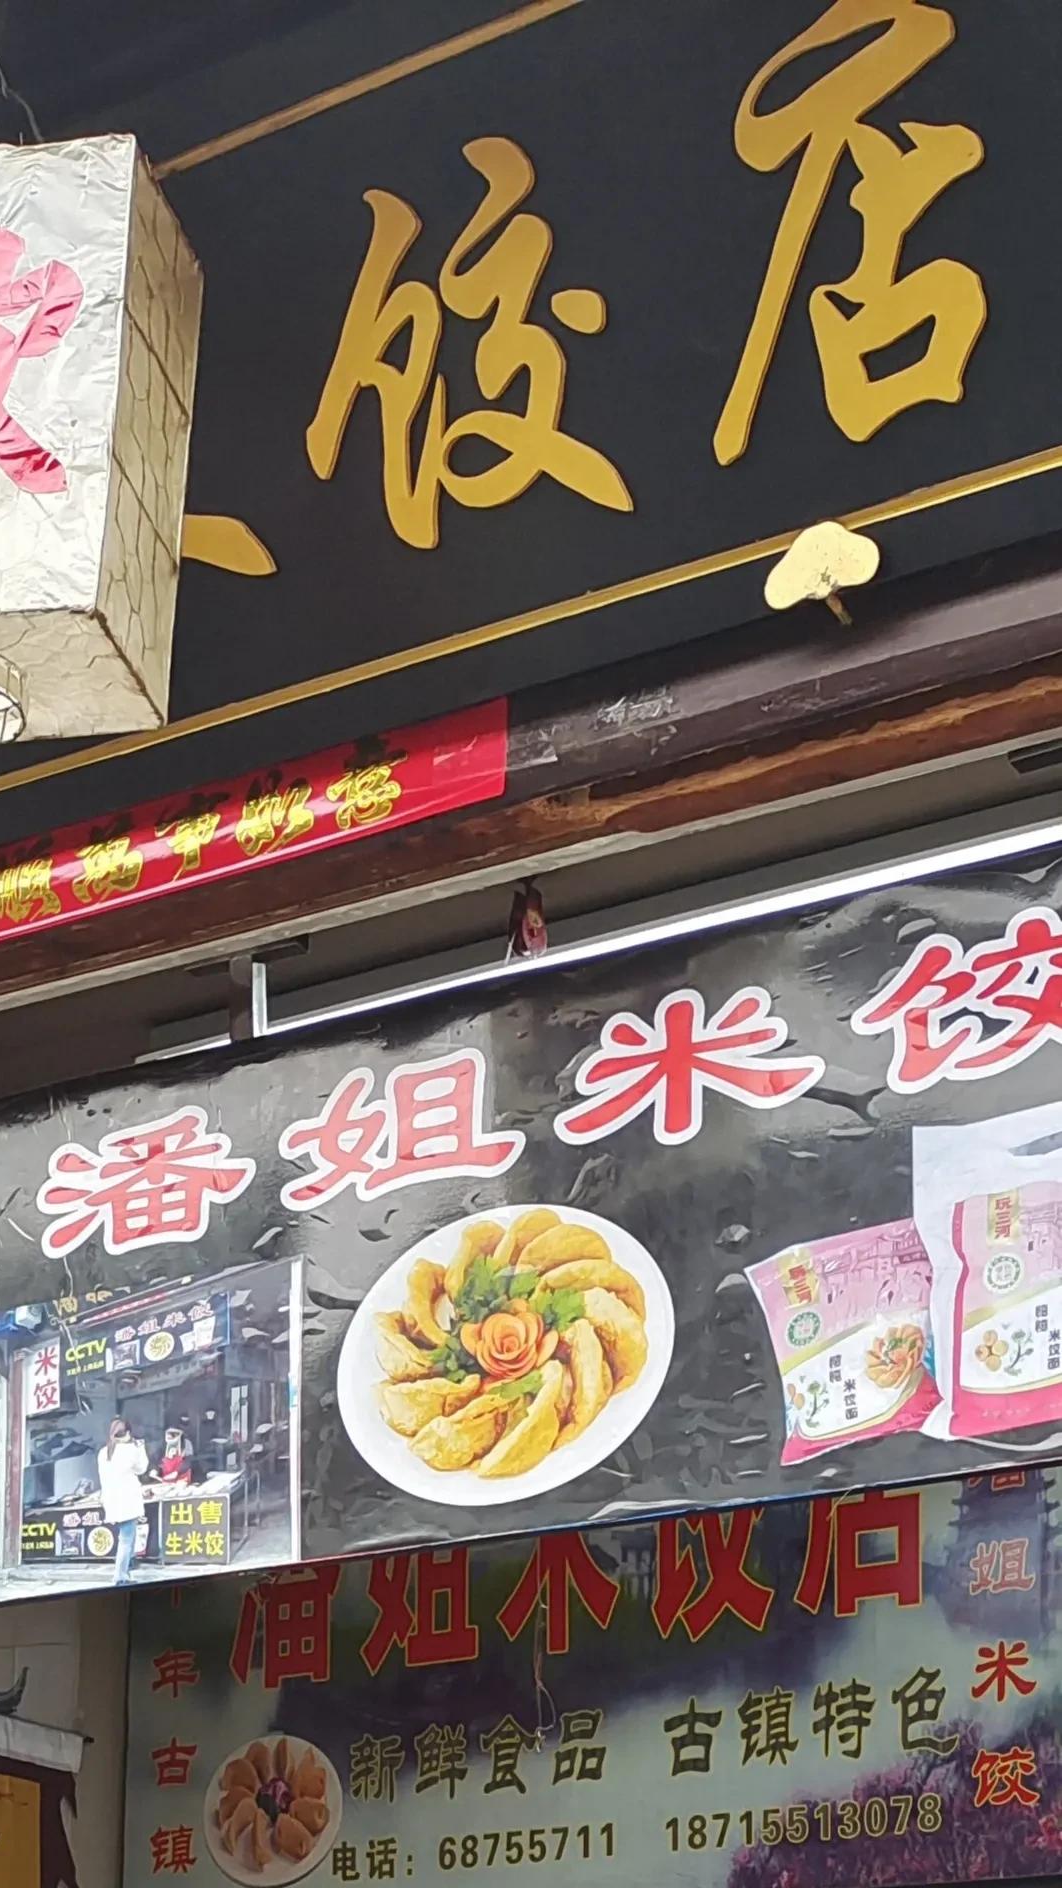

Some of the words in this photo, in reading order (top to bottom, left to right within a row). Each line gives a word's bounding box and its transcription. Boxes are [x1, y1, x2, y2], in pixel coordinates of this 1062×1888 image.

[38, 906, 1062, 1260] 潘姐米饺
[33, 1346, 60, 1411] 米饺
[64, 1336, 109, 1363] CCTV
[21, 1522, 58, 1538] CCTV
[169, 1501, 225, 1526] 出售
[165, 1531, 225, 1557] 生米饺
[969, 1471, 1039, 1809] 姐米饺
[348, 1707, 605, 1804] 新鲜食品
[663, 1666, 960, 1776] 古镇特色
[666, 1794, 942, 1854] 18715513078
